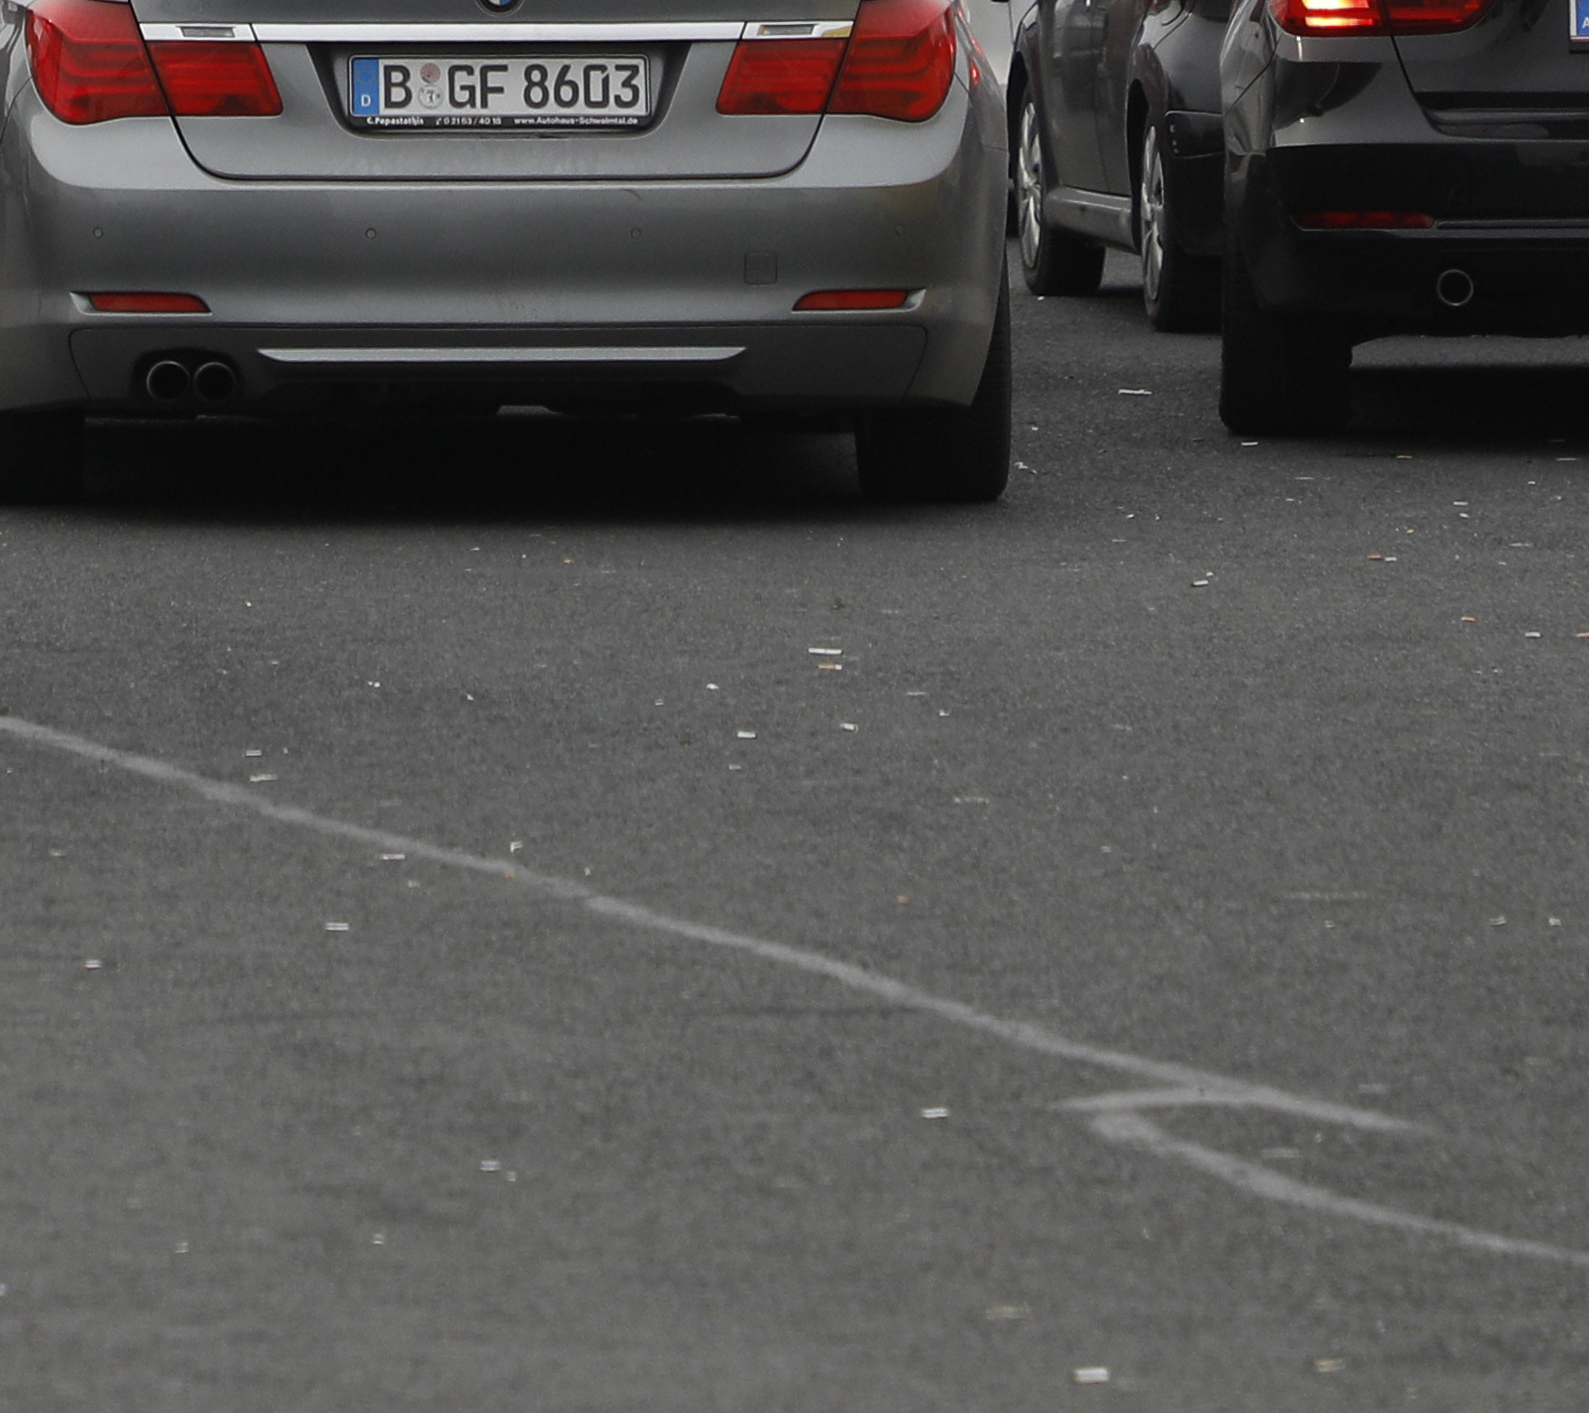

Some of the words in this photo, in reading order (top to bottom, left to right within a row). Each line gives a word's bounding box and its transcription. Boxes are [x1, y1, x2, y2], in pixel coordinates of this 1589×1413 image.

[361, 94, 371, 107] D
[383, 64, 413, 109] B
[447, 64, 509, 109] GF
[523, 63, 640, 109] 8603
